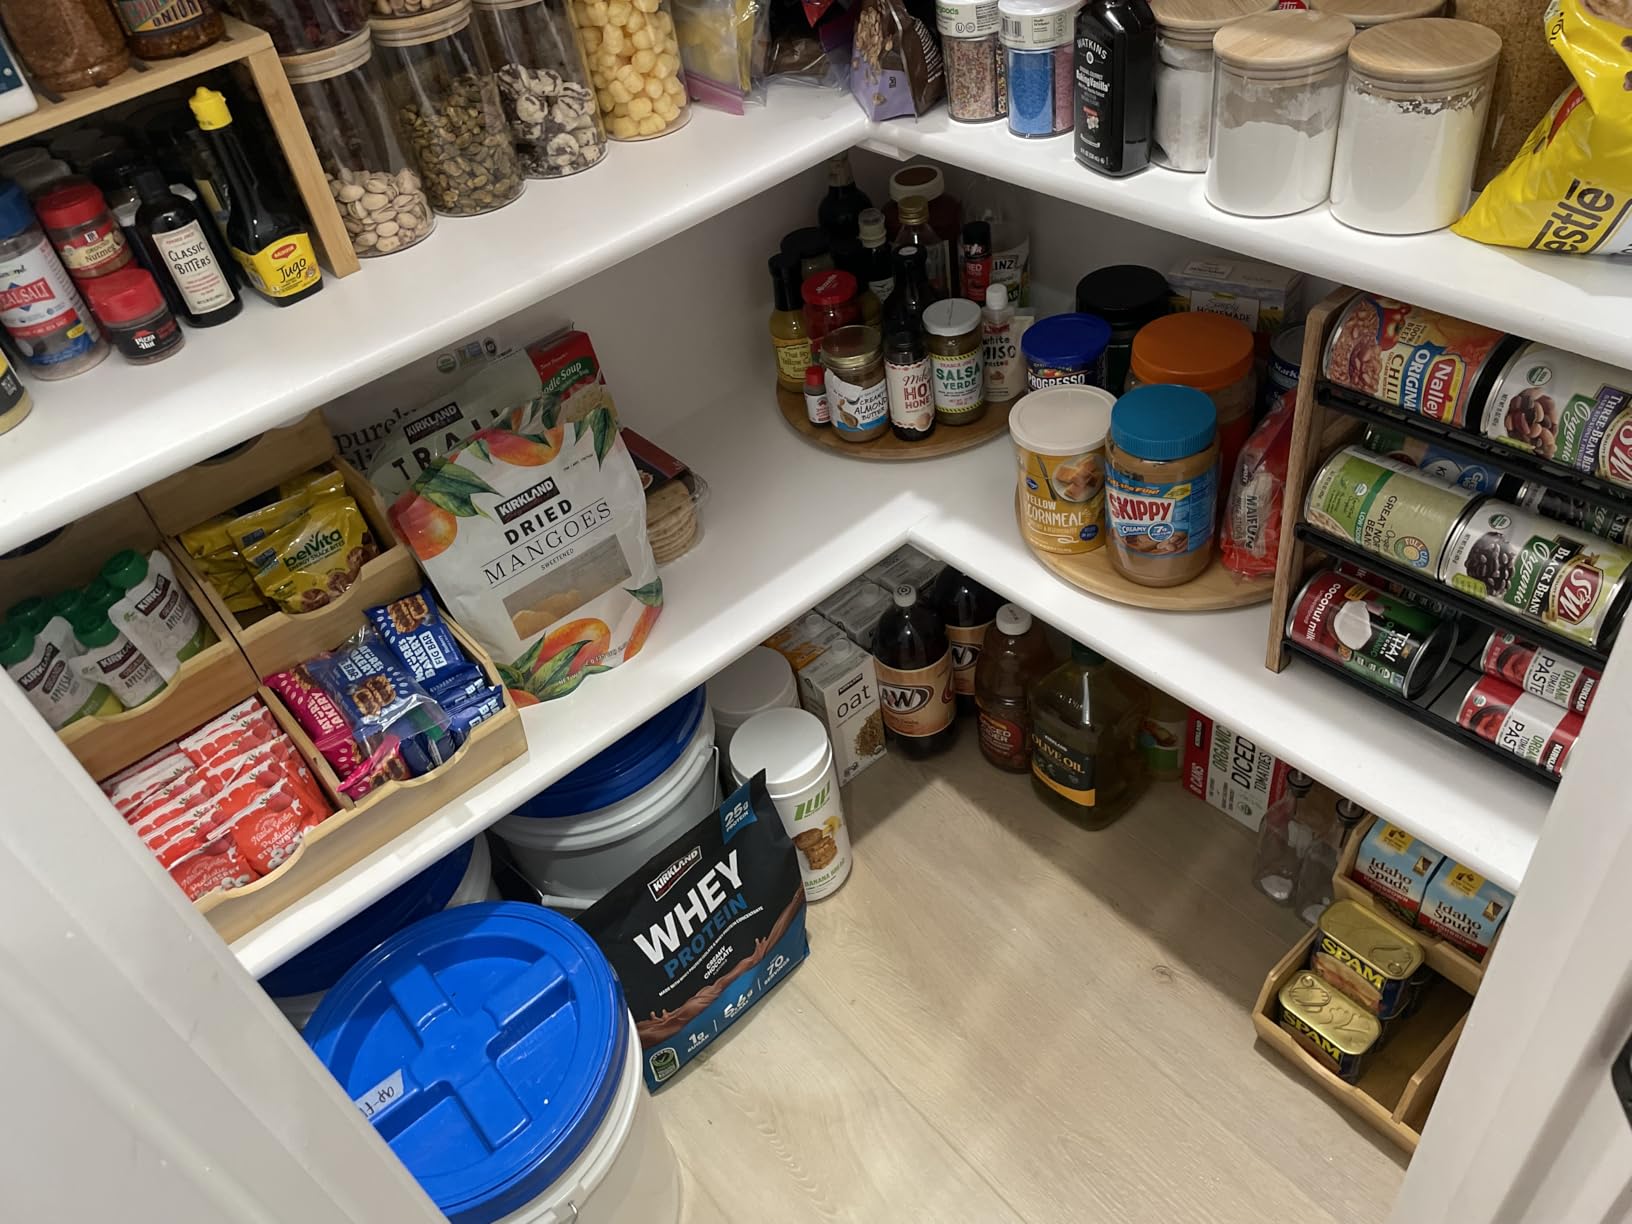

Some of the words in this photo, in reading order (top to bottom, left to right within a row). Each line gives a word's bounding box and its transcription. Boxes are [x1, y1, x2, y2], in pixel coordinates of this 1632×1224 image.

[1077, 38, 1107, 59] WATKINS
[85, 244, 117, 262] Nutmeg
[168, 241, 205, 262] CLASSIC
[174, 255, 211, 275] BITTERS
[995, 260, 1014, 270] INZ
[276, 258, 306, 283] Jugo
[561, 361, 582, 379] Soup
[936, 363, 980, 381] SALSA
[943, 378, 977, 390] VERDE
[1387, 353, 1404, 401] CHILI
[854, 397, 888, 415] ALMOND
[1424, 364, 1453, 418] Nalley
[406, 404, 459, 438] KIRKLAND
[861, 406, 884, 421] BUTTER
[1562, 401, 1592, 462] Organic
[499, 479, 555, 517] KIRKLAND
[1027, 493, 1057, 510] YELLOW
[1109, 493, 1171, 521] SKIPPY
[1378, 495, 1397, 529] GREAT
[504, 499, 573, 545] DRIED
[1026, 508, 1084, 527] CORNMEAL
[1121, 525, 1147, 534] CREAMY
[283, 528, 344, 568] belVita
[482, 502, 612, 585] MANGOES
[541, 548, 575, 571] SWEETENED
[1514, 541, 1551, 604] Organic
[1543, 546, 1570, 582] BLACK
[1313, 583, 1341, 622] coconut
[1529, 583, 1549, 614] BEANS
[422, 633, 437, 651] BAR
[1306, 621, 1317, 642] milk
[406, 635, 436, 678] BAKERY
[432, 650, 446, 666] FIG
[1384, 632, 1411, 662] THAI
[1530, 655, 1555, 695] PASTE
[837, 684, 872, 719] oat
[1576, 677, 1596, 712] KIRKLAND
[1213, 724, 1232, 773] ORGANIC
[1503, 719, 1526, 753] PAST
[1032, 733, 1062, 762] OLIVE
[1064, 757, 1086, 775] OIL
[1231, 735, 1256, 790] DICED
[1254, 751, 1272, 794] TOMATOES
[724, 800, 750, 828] 25g
[726, 811, 750, 832] PROTEIN
[260, 821, 297, 850] Probiotic
[652, 849, 699, 892] KIRKLAND
[1367, 866, 1410, 894] Spuds
[1370, 857, 1412, 885] Idaho
[633, 849, 743, 965] WHEY
[1437, 901, 1482, 930] Idaho
[664, 892, 748, 979] PROTEIN
[1433, 908, 1480, 940] Spuds
[703, 946, 734, 980] CHOCOLATE
[706, 945, 726, 970] CREAMY
[766, 954, 784, 976] 70
[1321, 937, 1385, 990] SPAM
[688, 1031, 705, 1046] 1g
[1283, 1009, 1341, 1061] SPAM
